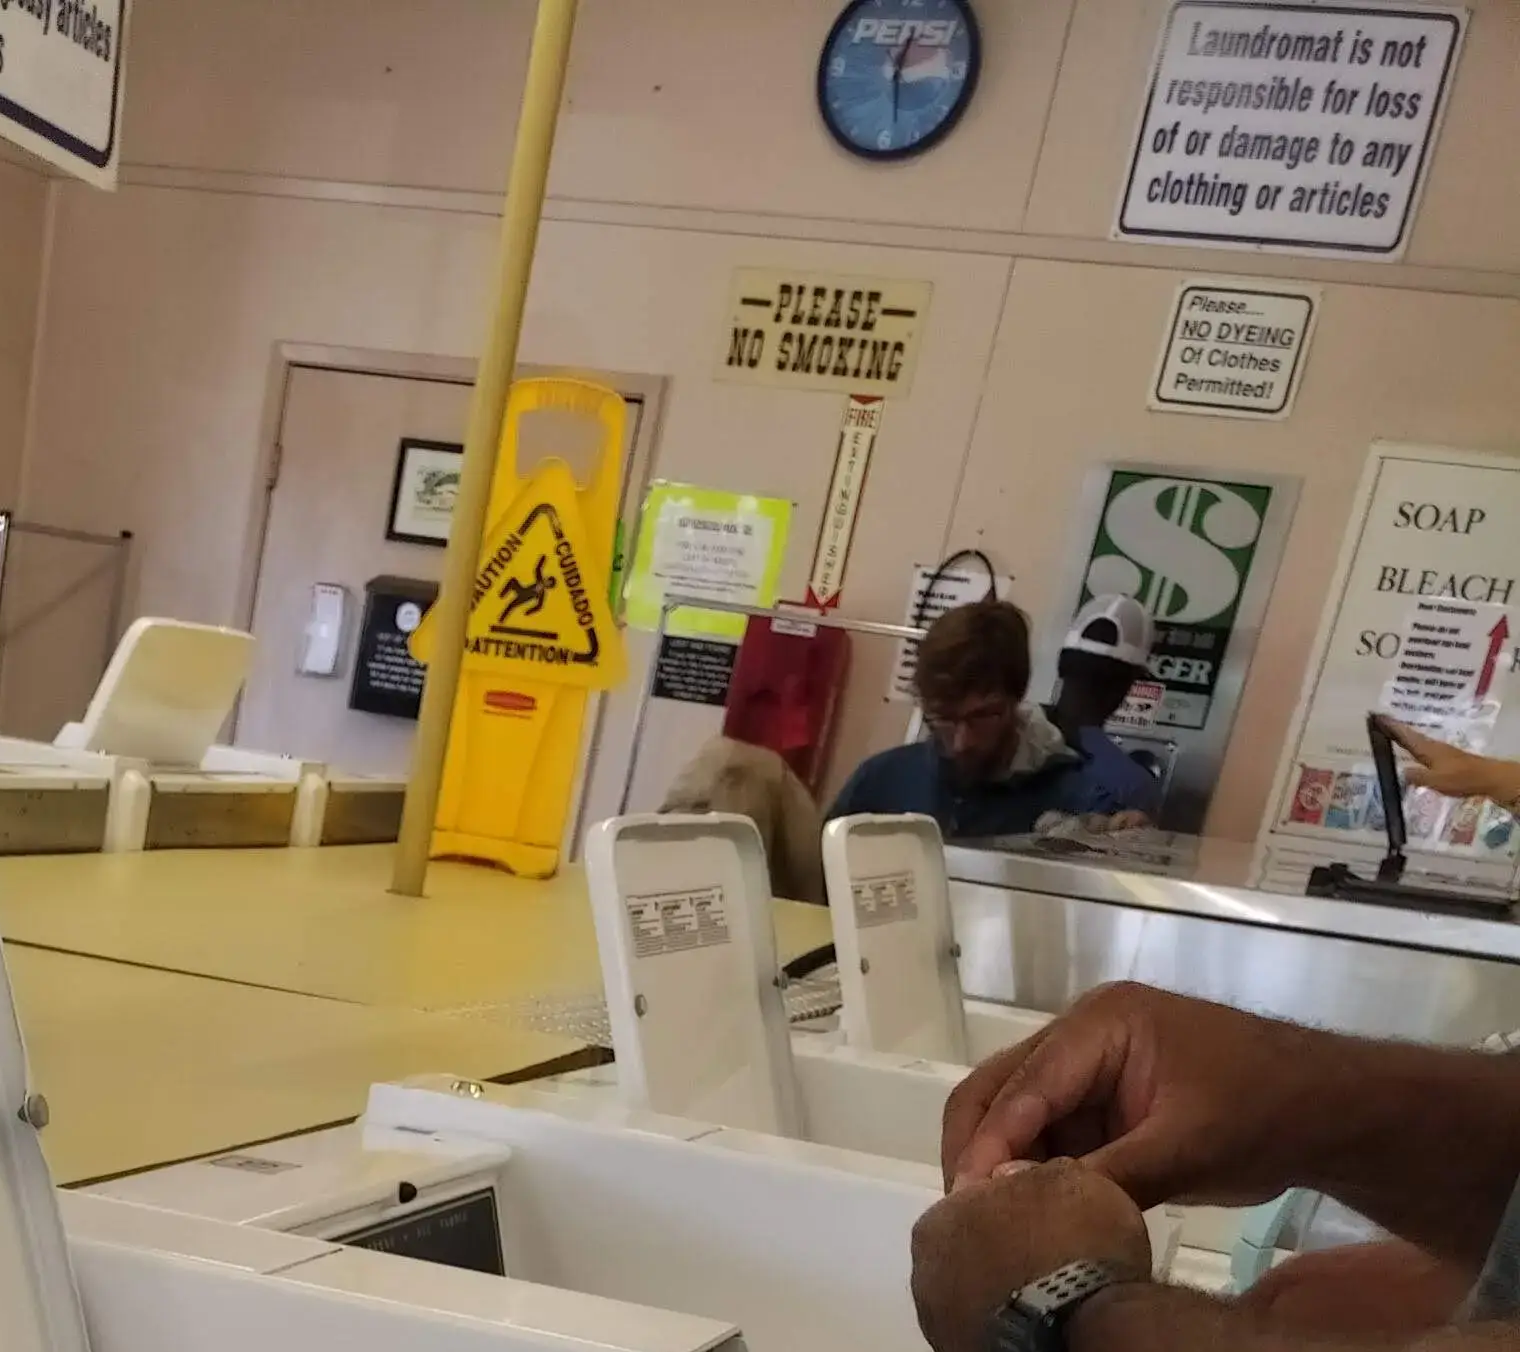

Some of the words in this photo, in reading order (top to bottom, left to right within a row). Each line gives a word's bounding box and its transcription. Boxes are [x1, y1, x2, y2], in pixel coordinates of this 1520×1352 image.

[850, 18, 959, 47] PEPSI
[1187, 20, 1346, 64] Laundromat
[1348, 29, 1374, 66] is
[1379, 35, 1427, 69] not
[1165, 75, 1315, 114] responsible
[1322, 79, 1361, 116] for
[1365, 82, 1423, 120] loss
[1152, 121, 1181, 154] of
[1185, 129, 1212, 157] or
[1217, 125, 1321, 171] damage
[1328, 132, 1355, 166] to
[1361, 139, 1413, 178] any
[1146, 170, 1249, 216] clothing
[1255, 183, 1282, 212] or
[1289, 181, 1391, 219] articles
[773, 283, 882, 331] PLEASE
[1181, 319, 1212, 338] NO
[1217, 322, 1295, 347] DYEING
[726, 327, 765, 369] NO
[776, 331, 905, 382] SMOKING
[1180, 346, 1204, 365] Of
[1208, 348, 1283, 373] Clothes
[1174, 372, 1275, 400] Permitted!
[845, 407, 877, 429] FIRE
[1393, 500, 1487, 534] SOAP
[470, 533, 523, 611] AUTION
[556, 540, 594, 628] CUIDADO
[1376, 565, 1516, 605] BLEACH
[470, 637, 570, 665] ATTENTION
